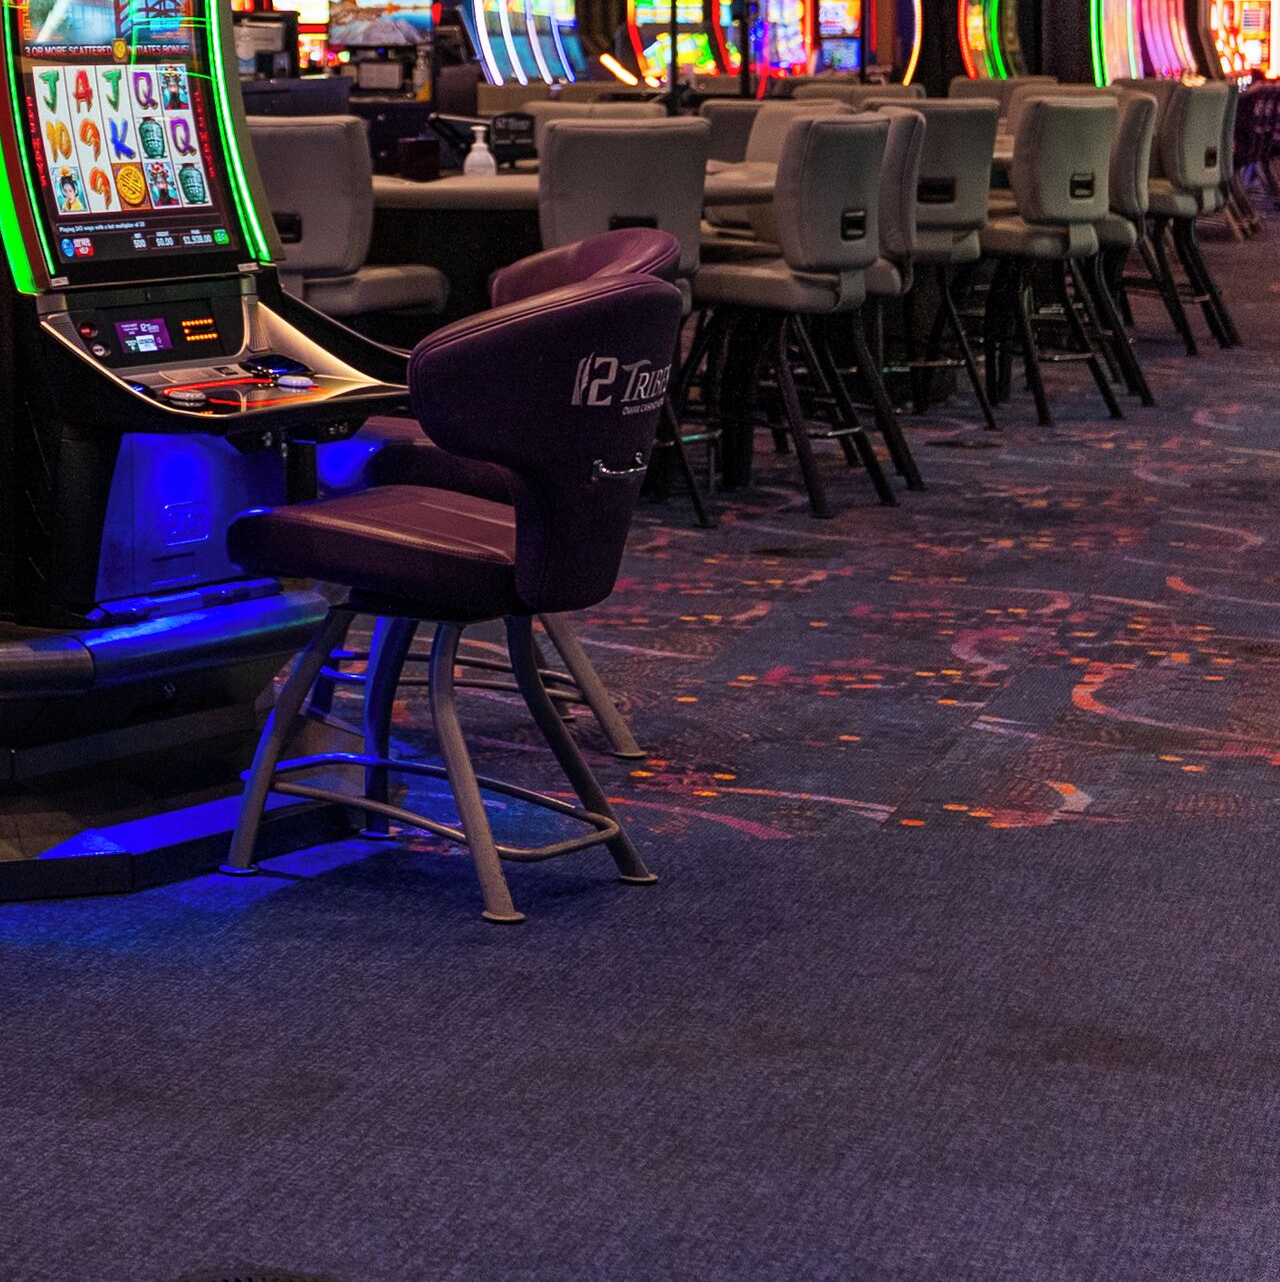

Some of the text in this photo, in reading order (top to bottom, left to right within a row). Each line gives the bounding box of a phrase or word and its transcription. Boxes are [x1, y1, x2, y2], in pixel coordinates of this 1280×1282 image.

[24, 47, 31, 57] 3
[31, 47, 43, 57] OR
[44, 47, 68, 57] MORE
[68, 46, 113, 56] SCATTERED
[39, 69, 158, 114] J A J Q
[46, 119, 72, 163] 10
[80, 118, 101, 162] 9
[108, 117, 136, 160] K
[169, 117, 198, 156] Q
[89, 166, 112, 210] 9
[571, 351, 619, 406] 12
